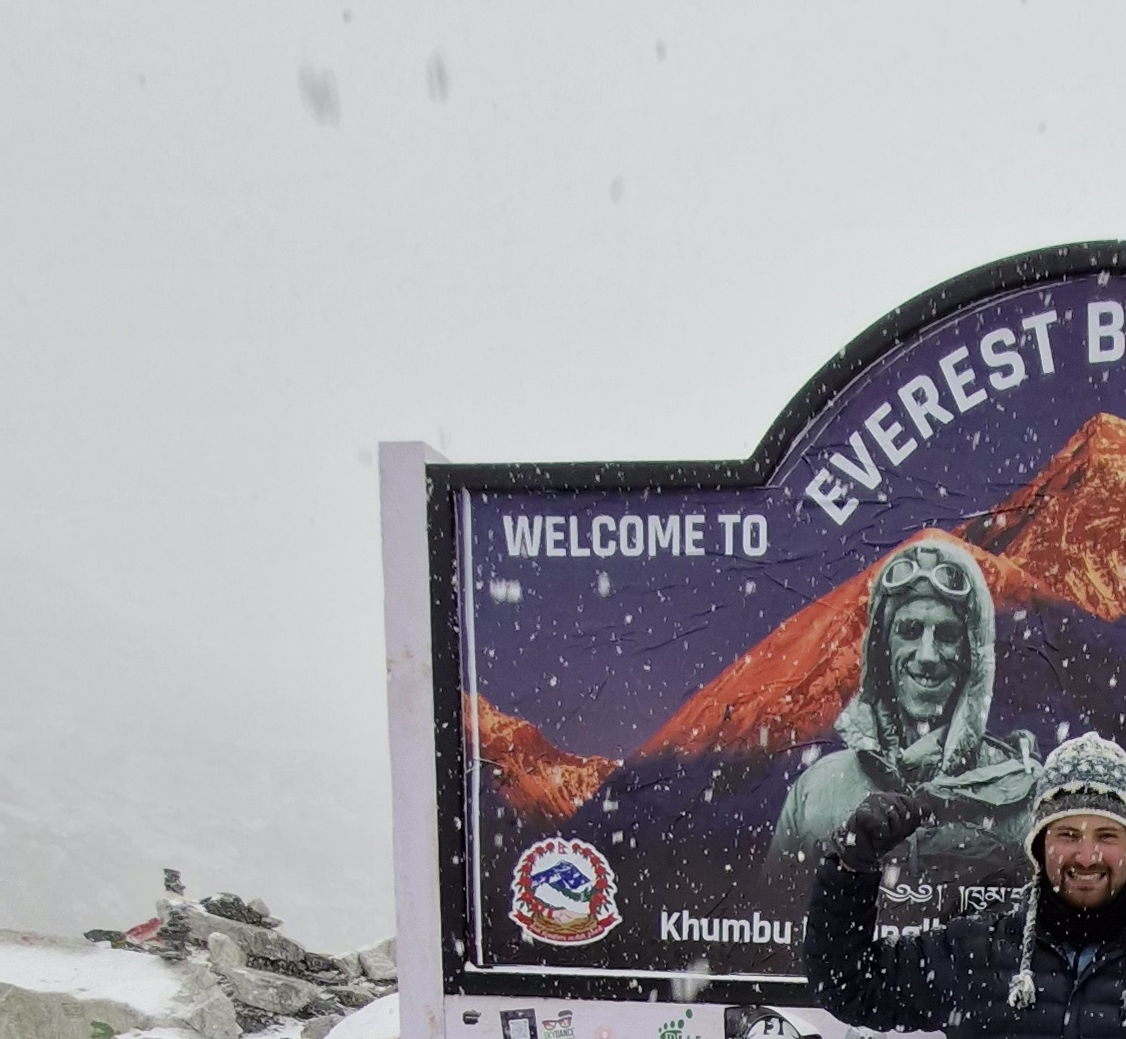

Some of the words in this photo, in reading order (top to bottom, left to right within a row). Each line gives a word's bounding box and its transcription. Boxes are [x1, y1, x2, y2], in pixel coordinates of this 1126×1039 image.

[806, 311, 1057, 525] EVEREST
[503, 514, 705, 558] WELCOME
[717, 514, 768, 557] TO
[661, 909, 792, 945] Khumbu
